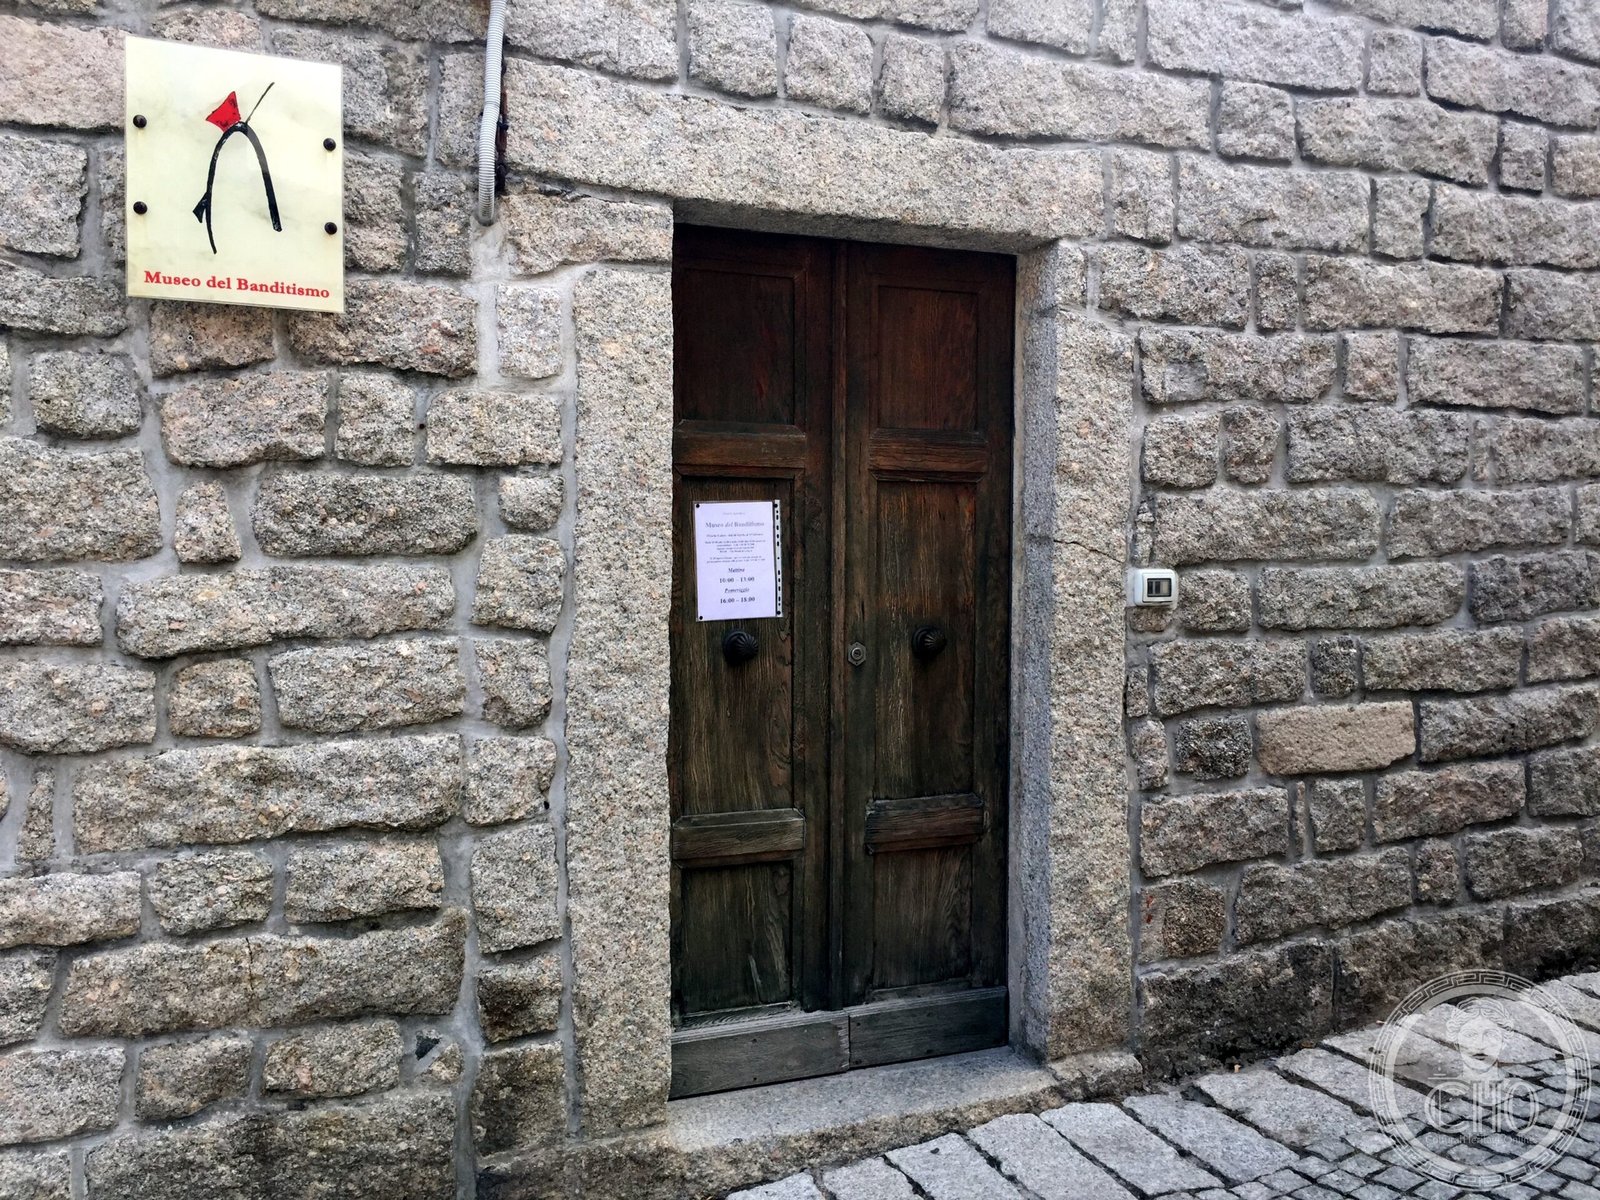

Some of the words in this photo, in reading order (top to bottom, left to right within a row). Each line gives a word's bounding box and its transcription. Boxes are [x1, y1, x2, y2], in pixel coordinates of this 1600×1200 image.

[144, 270, 201, 287] Museo
[206, 276, 232, 290] del
[236, 278, 330, 298] Banditismo
